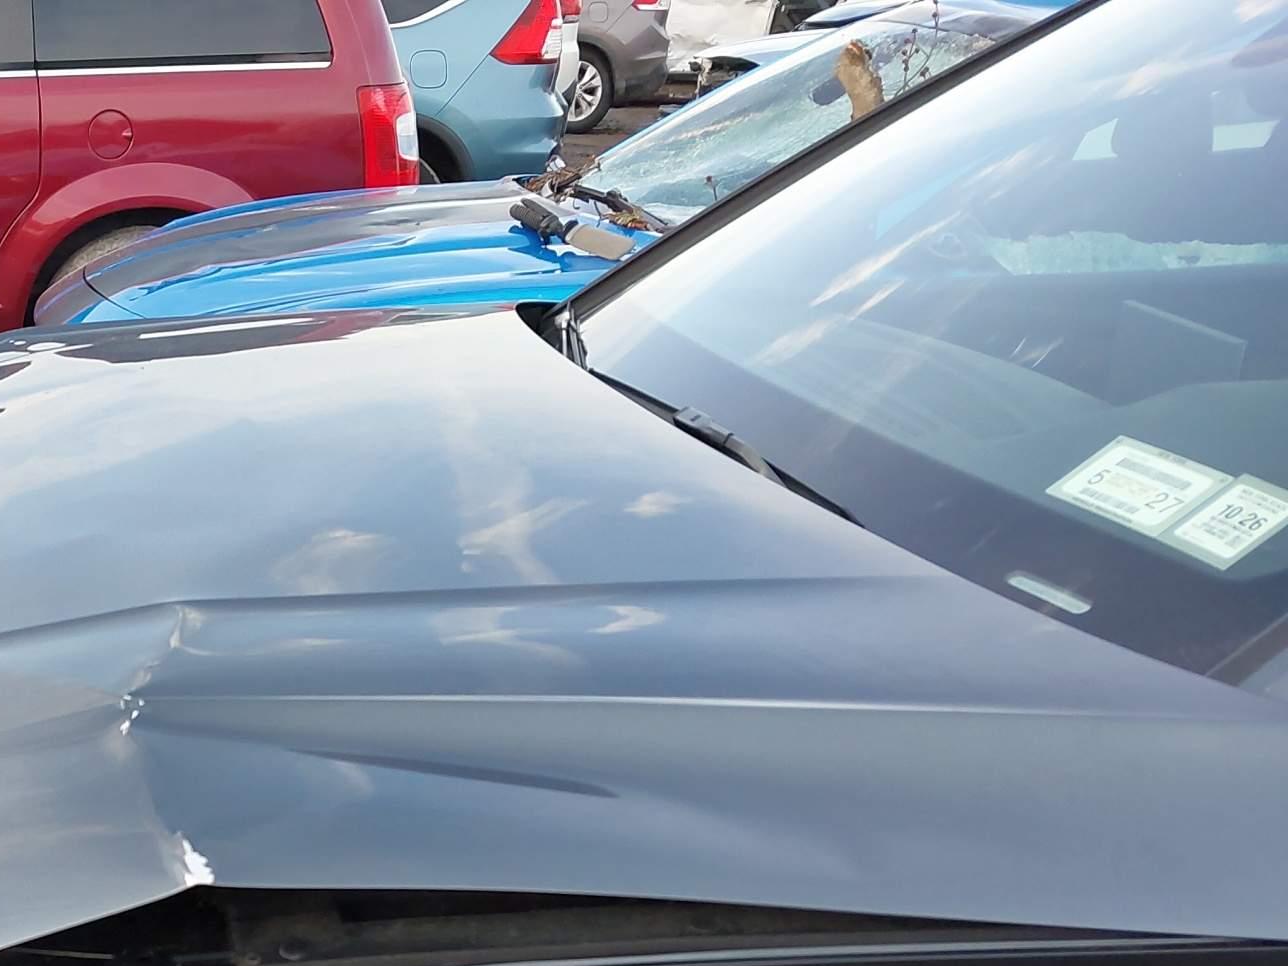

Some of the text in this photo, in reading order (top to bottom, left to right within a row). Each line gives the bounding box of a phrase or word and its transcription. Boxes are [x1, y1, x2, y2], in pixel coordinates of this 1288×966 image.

[1087, 469, 1112, 485] 5
[1144, 492, 1185, 513] 27
[1217, 503, 1269, 531] 10 26
